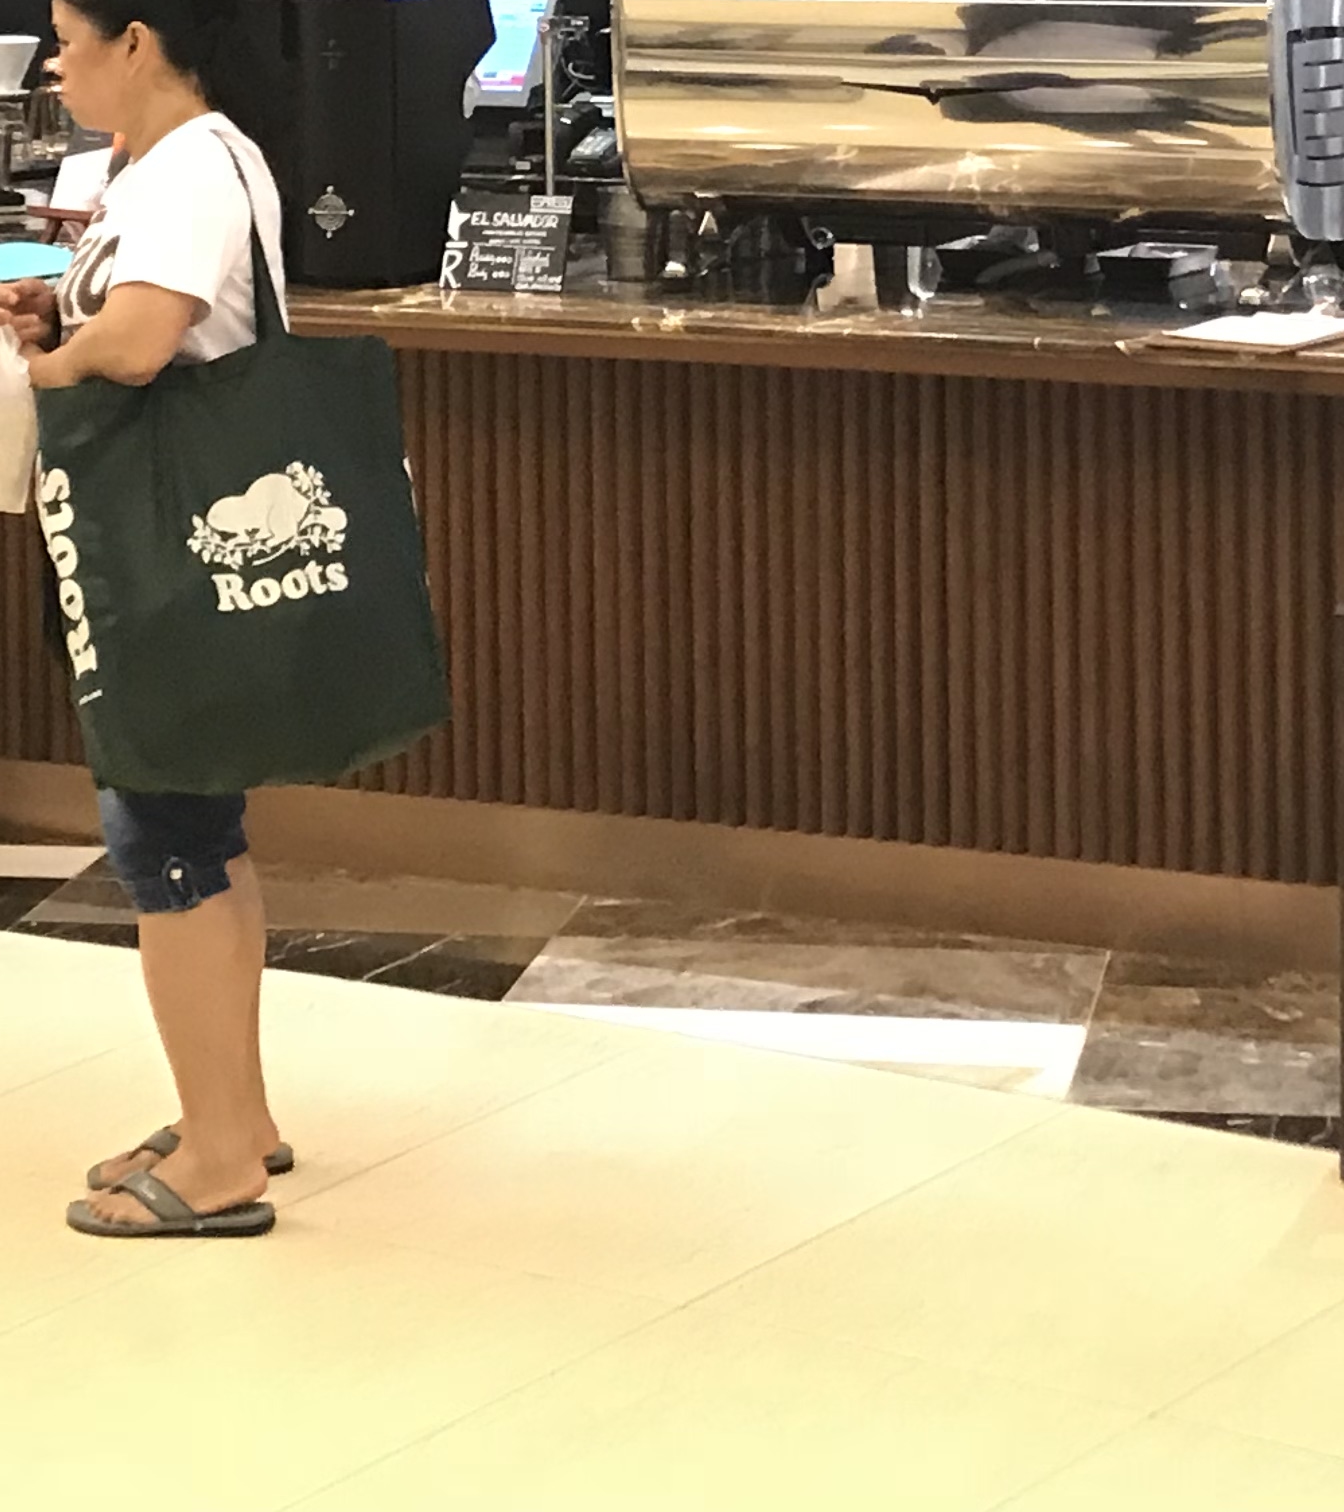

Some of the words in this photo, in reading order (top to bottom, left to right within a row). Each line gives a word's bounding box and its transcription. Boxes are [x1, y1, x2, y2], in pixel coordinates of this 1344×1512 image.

[471, 211, 490, 226] EL
[492, 212, 558, 229] SALVADOR
[211, 558, 350, 612] Roots
